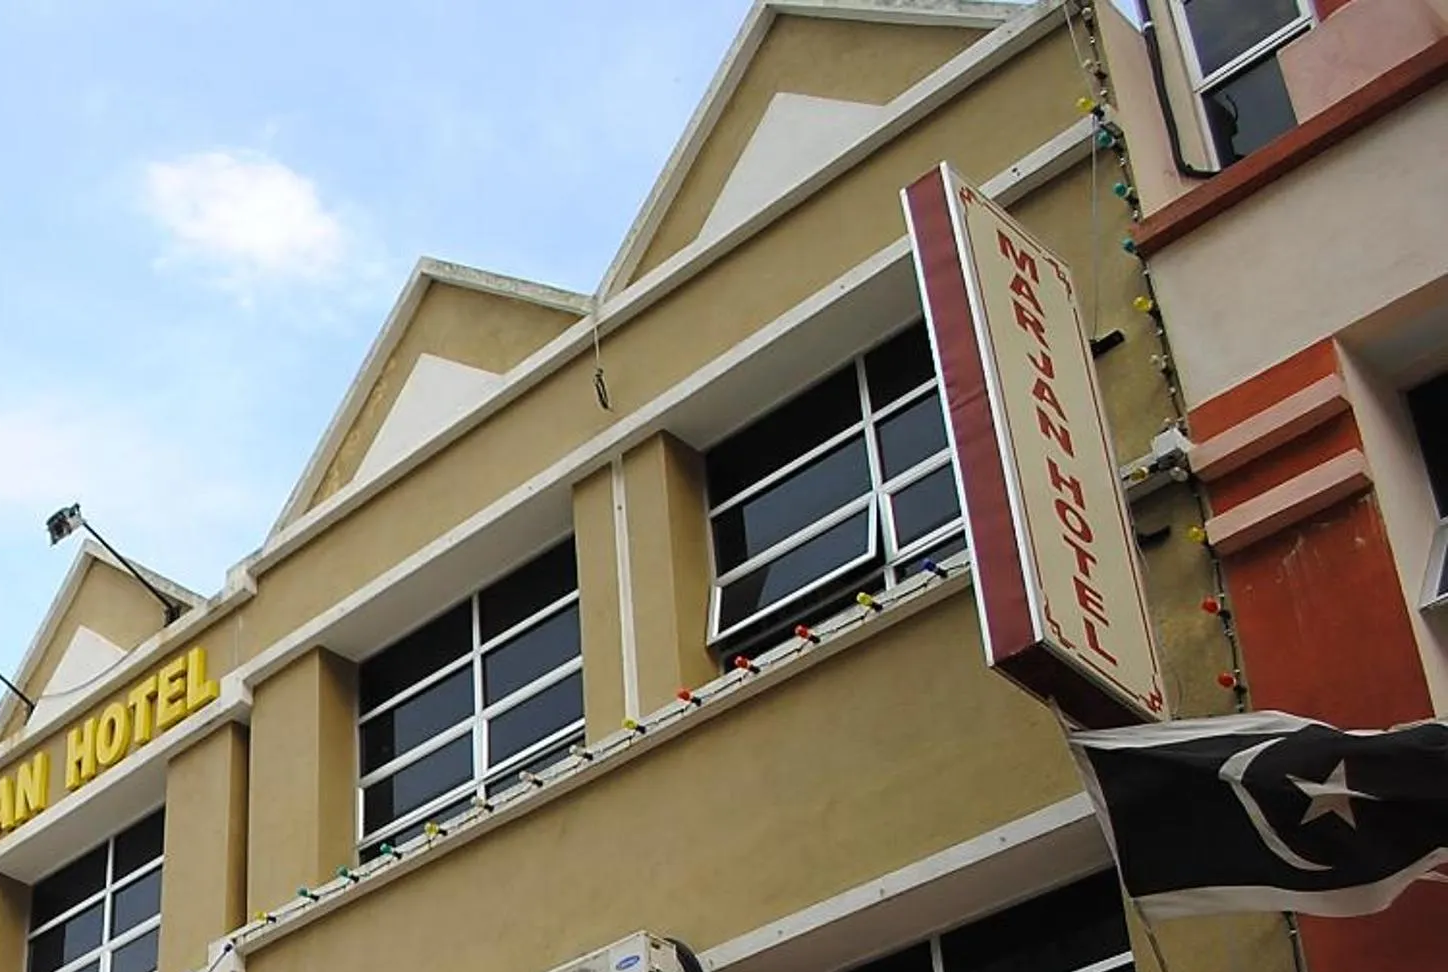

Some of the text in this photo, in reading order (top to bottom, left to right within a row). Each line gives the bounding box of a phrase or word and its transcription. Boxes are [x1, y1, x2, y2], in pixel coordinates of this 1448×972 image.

[996, 229, 1118, 668] MARJAN HOTEL
[65, 646, 219, 790] HOTEL
